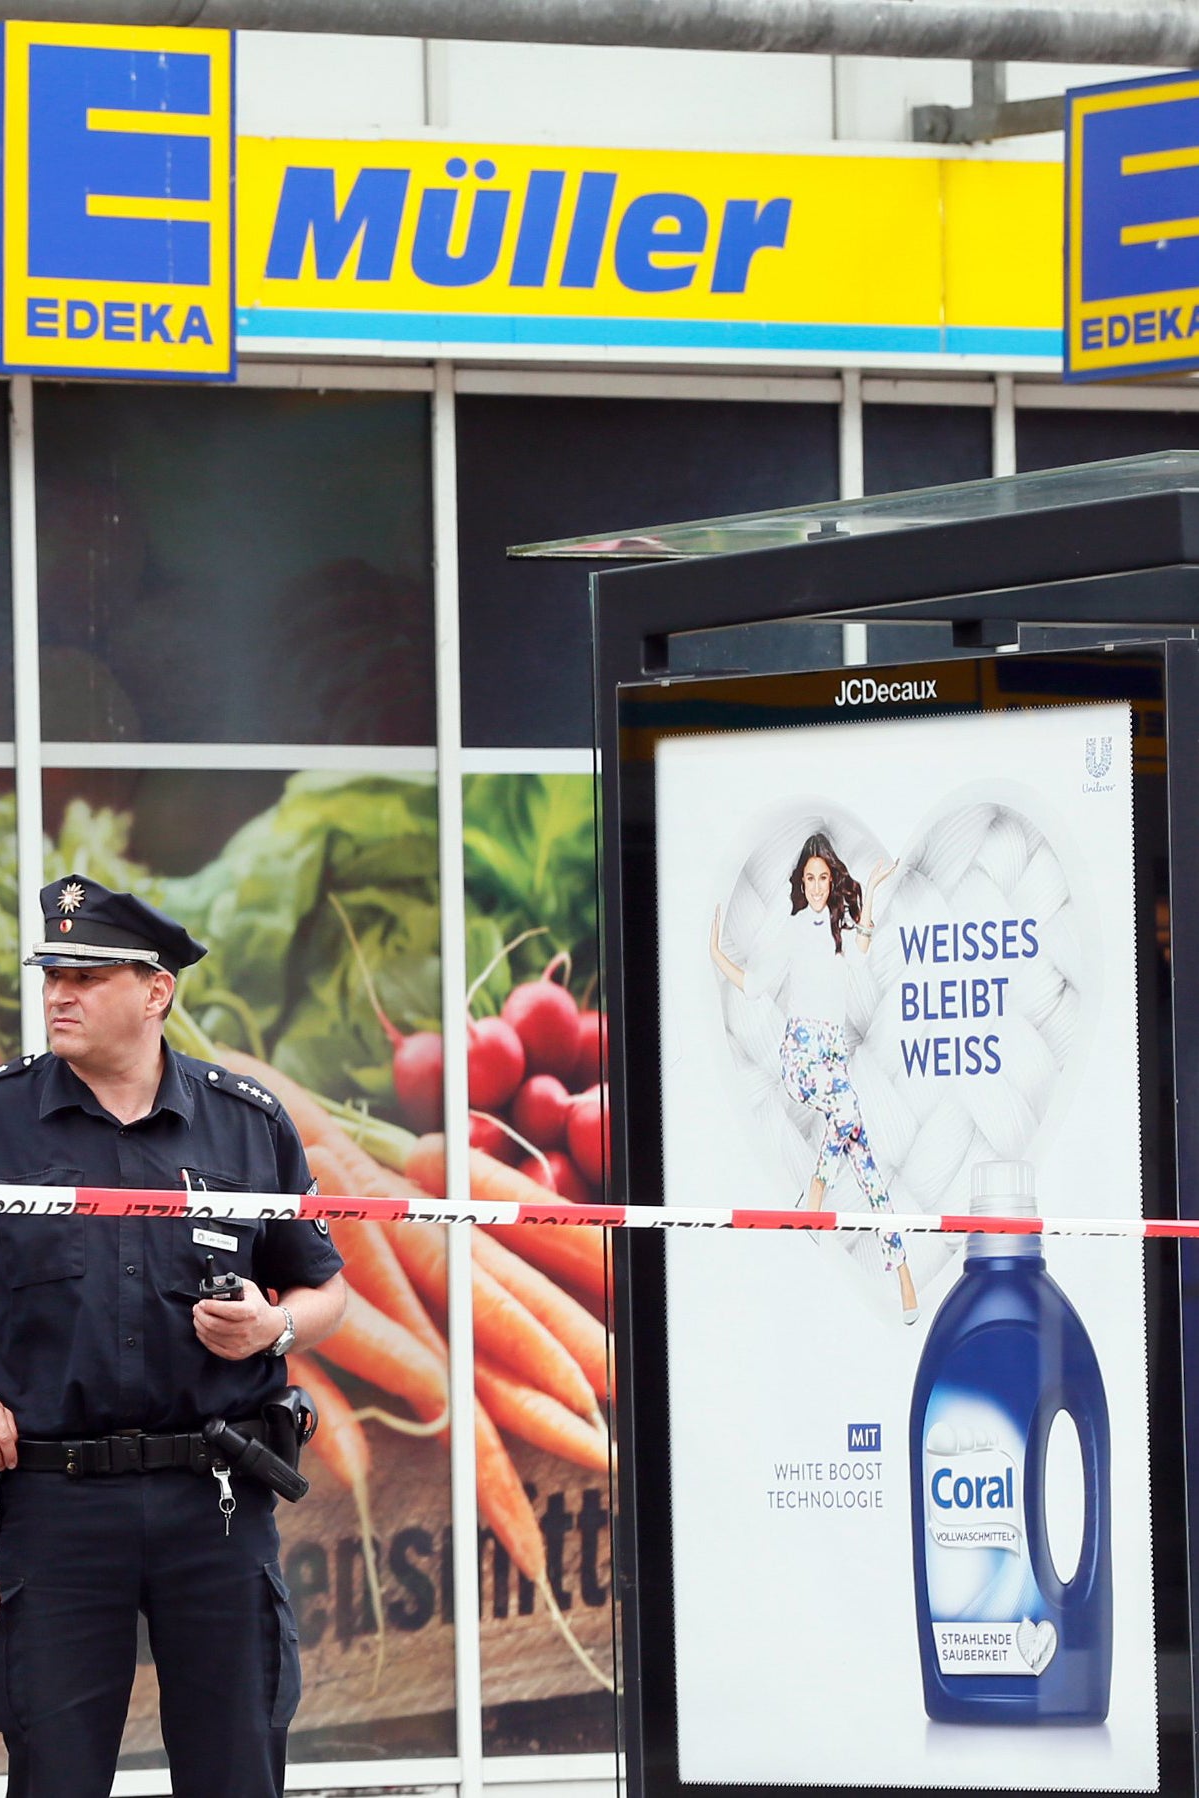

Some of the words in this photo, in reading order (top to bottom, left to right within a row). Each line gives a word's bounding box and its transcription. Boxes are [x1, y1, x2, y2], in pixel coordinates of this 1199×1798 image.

[265, 158, 792, 294] Müller
[25, 298, 214, 346] EDEKA
[834, 678, 938, 706] JCDecaux
[899, 918, 1039, 964] WEISSES
[900, 977, 1010, 1022] BLEIBT
[899, 1034, 1002, 1078] WEISS
[851, 1428, 879, 1447] MIT
[774, 1463, 824, 1481] WHITE
[828, 1462, 883, 1481] BOOST
[931, 1467, 1014, 1509] Coral
[767, 1490, 884, 1509] TECHNOLOGIE
[941, 1632, 1013, 1647] STRAHLENDE
[941, 1648, 1009, 1662] SAUBERKEIT
